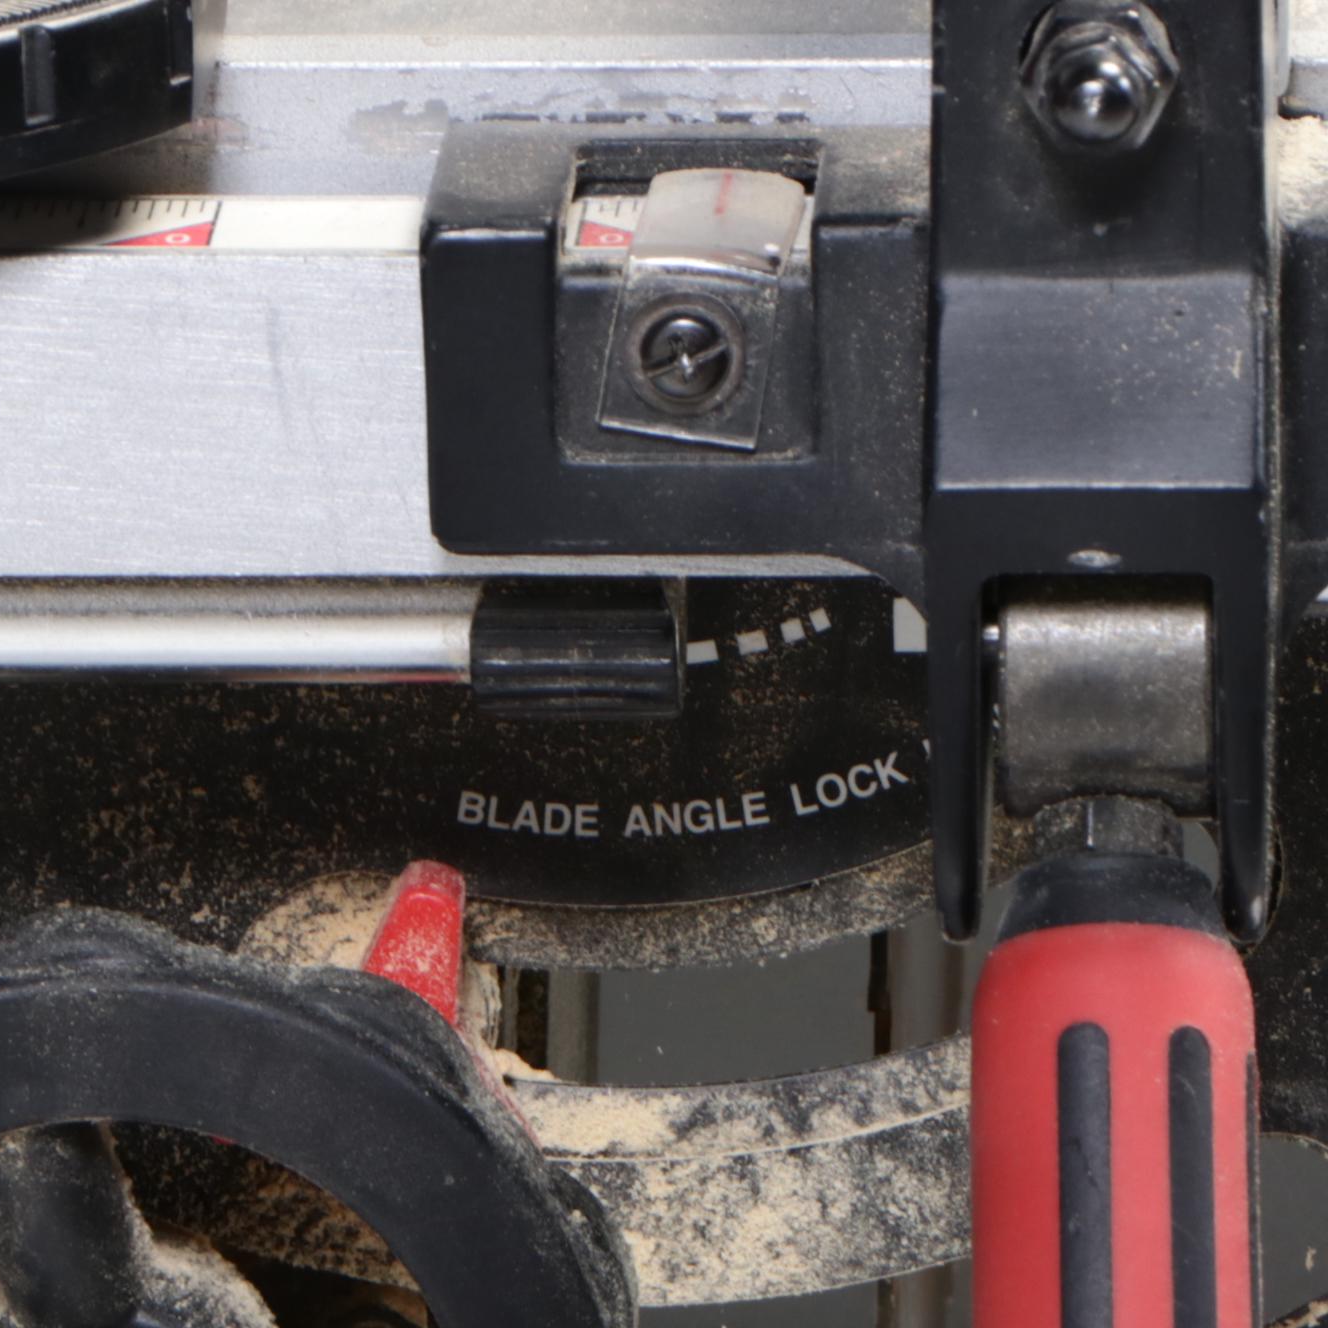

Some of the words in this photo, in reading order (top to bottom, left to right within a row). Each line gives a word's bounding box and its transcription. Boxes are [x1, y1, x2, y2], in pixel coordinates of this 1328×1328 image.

[457, 790, 600, 838] BLADE
[624, 791, 771, 839] ANGLE
[790, 751, 909, 817] LOCK
